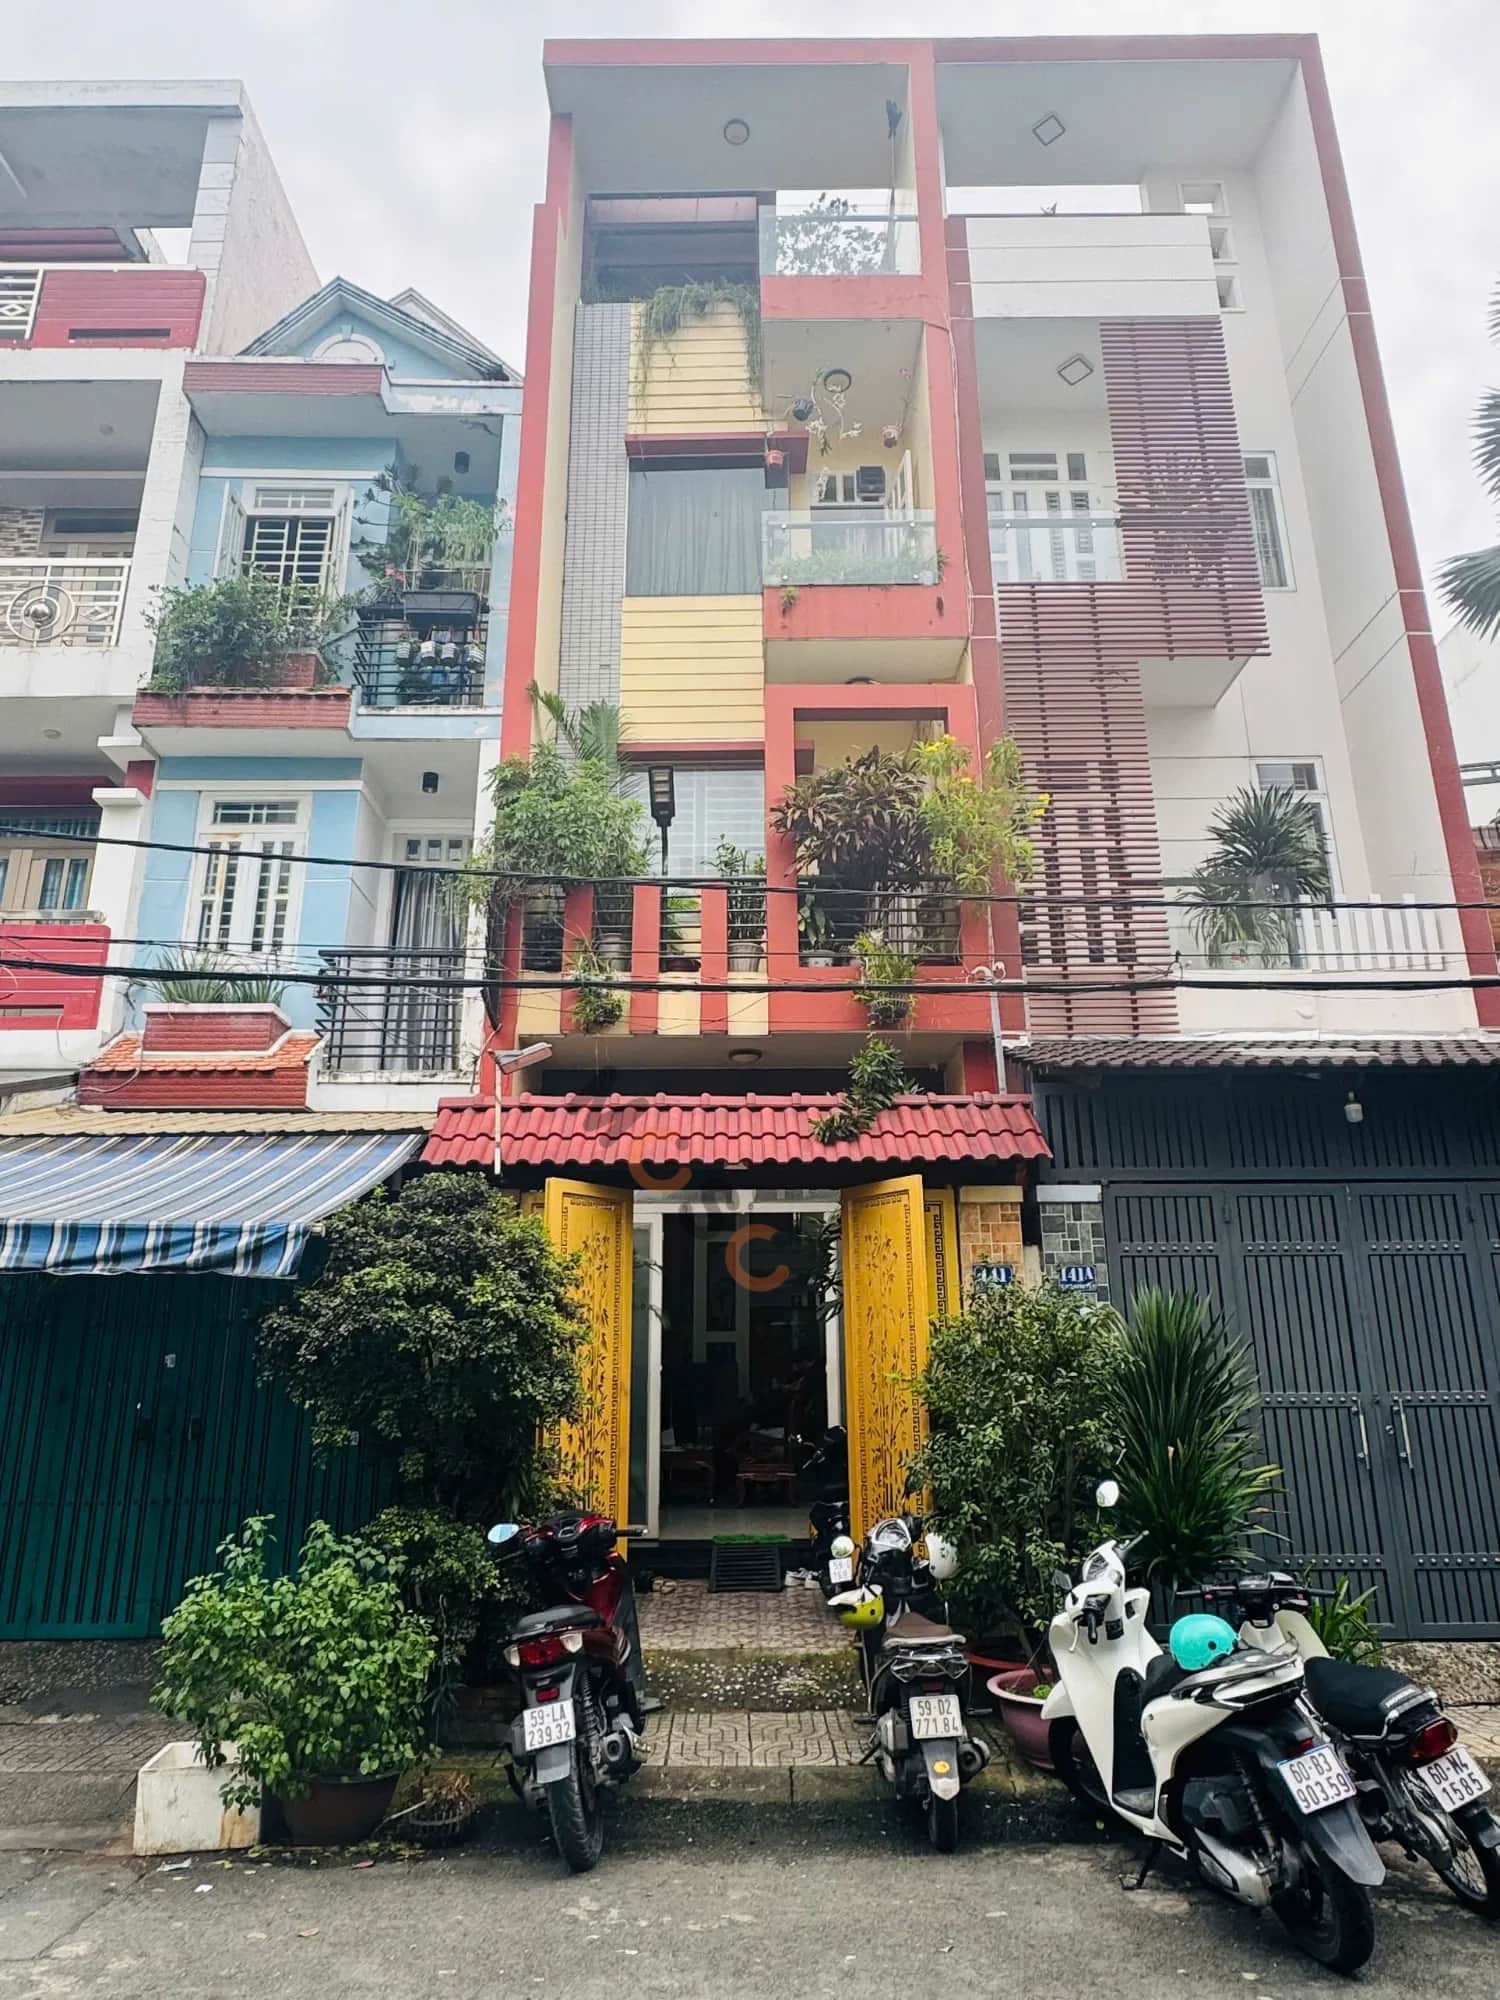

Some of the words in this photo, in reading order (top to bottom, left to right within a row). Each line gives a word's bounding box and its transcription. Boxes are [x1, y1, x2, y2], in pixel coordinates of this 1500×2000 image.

[531, 1704, 566, 1727] 59-LA
[528, 1721, 571, 1747] 239.32
[1289, 1753, 1332, 1784] 60-B3
[1297, 1772, 1350, 1809] 903.59
[1442, 1767, 1483, 1805] 1585
